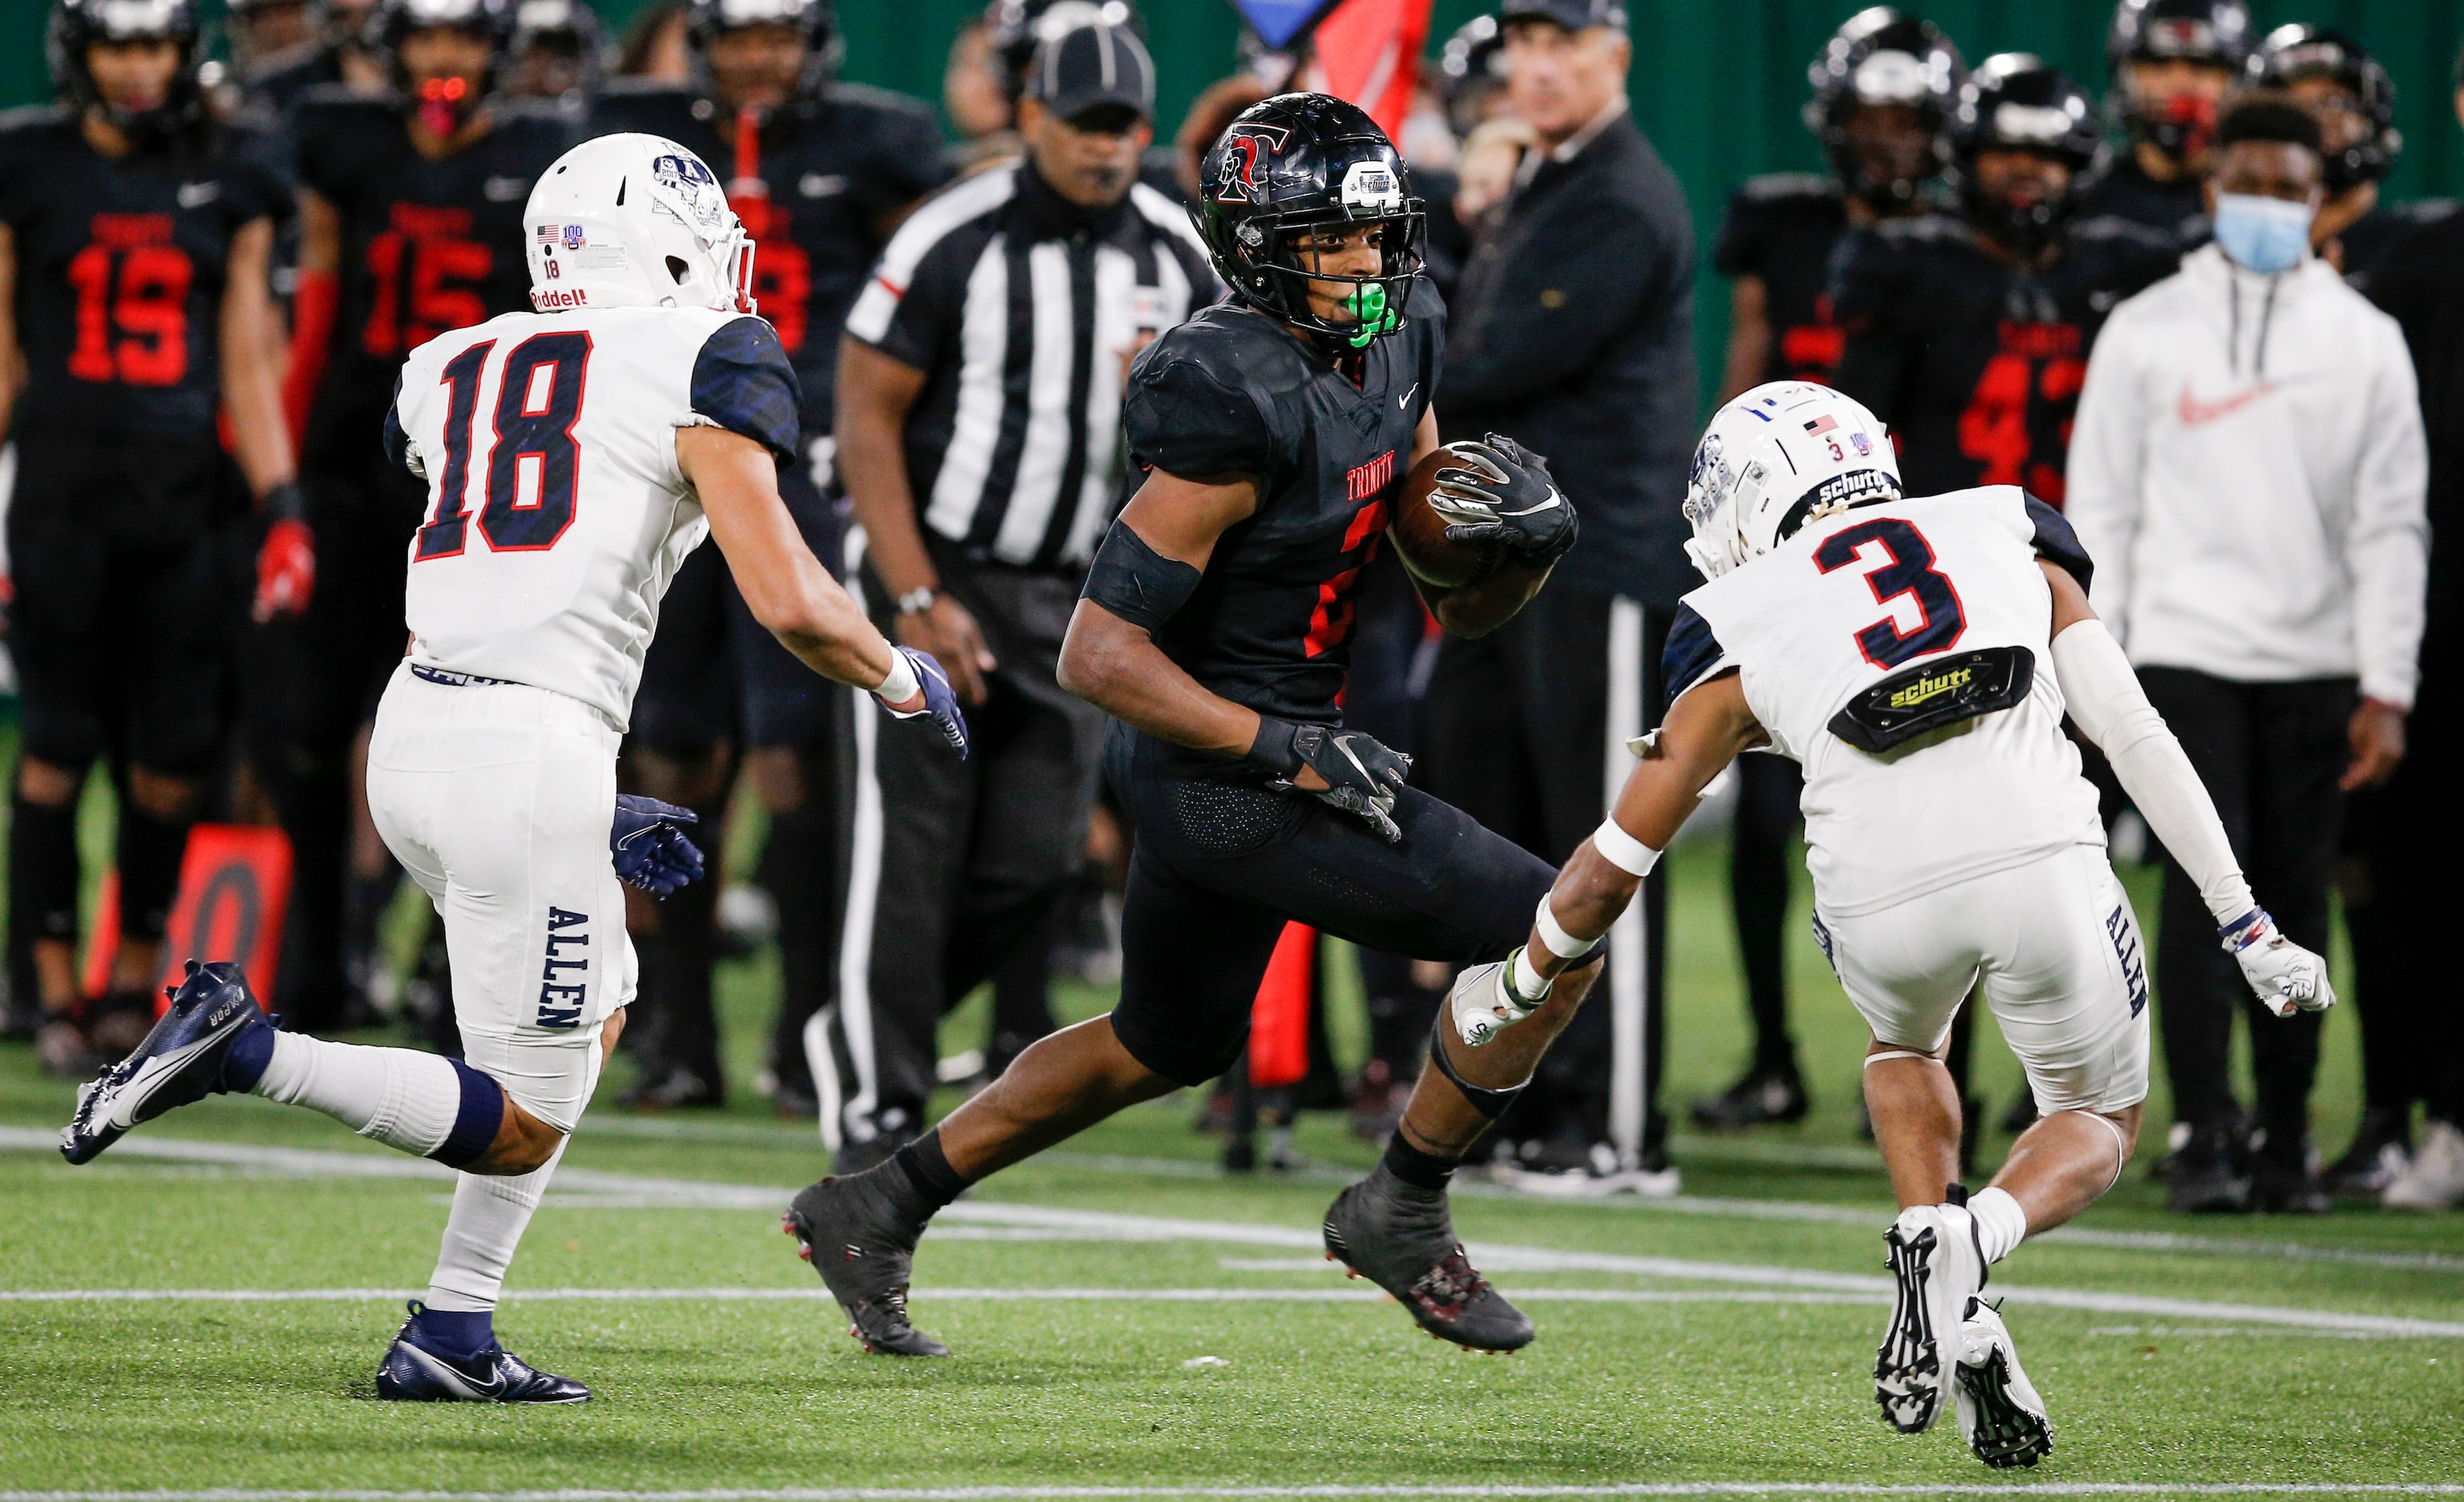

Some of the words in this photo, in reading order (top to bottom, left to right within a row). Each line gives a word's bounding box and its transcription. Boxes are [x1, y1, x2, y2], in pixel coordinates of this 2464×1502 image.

[661, 169, 678, 179] 2017
[563, 226, 582, 238] 100
[544, 258, 560, 280] 18
[413, 330, 594, 563] 18
[1828, 443, 1843, 461] 3
[1347, 449, 1395, 502] TRINITY
[1819, 469, 1883, 502] schutt
[1811, 517, 1967, 671] 3
[1891, 667, 1971, 709] schutt
[536, 905, 589, 1029] ALLEN
[2106, 904, 2148, 1021] ALLEN
